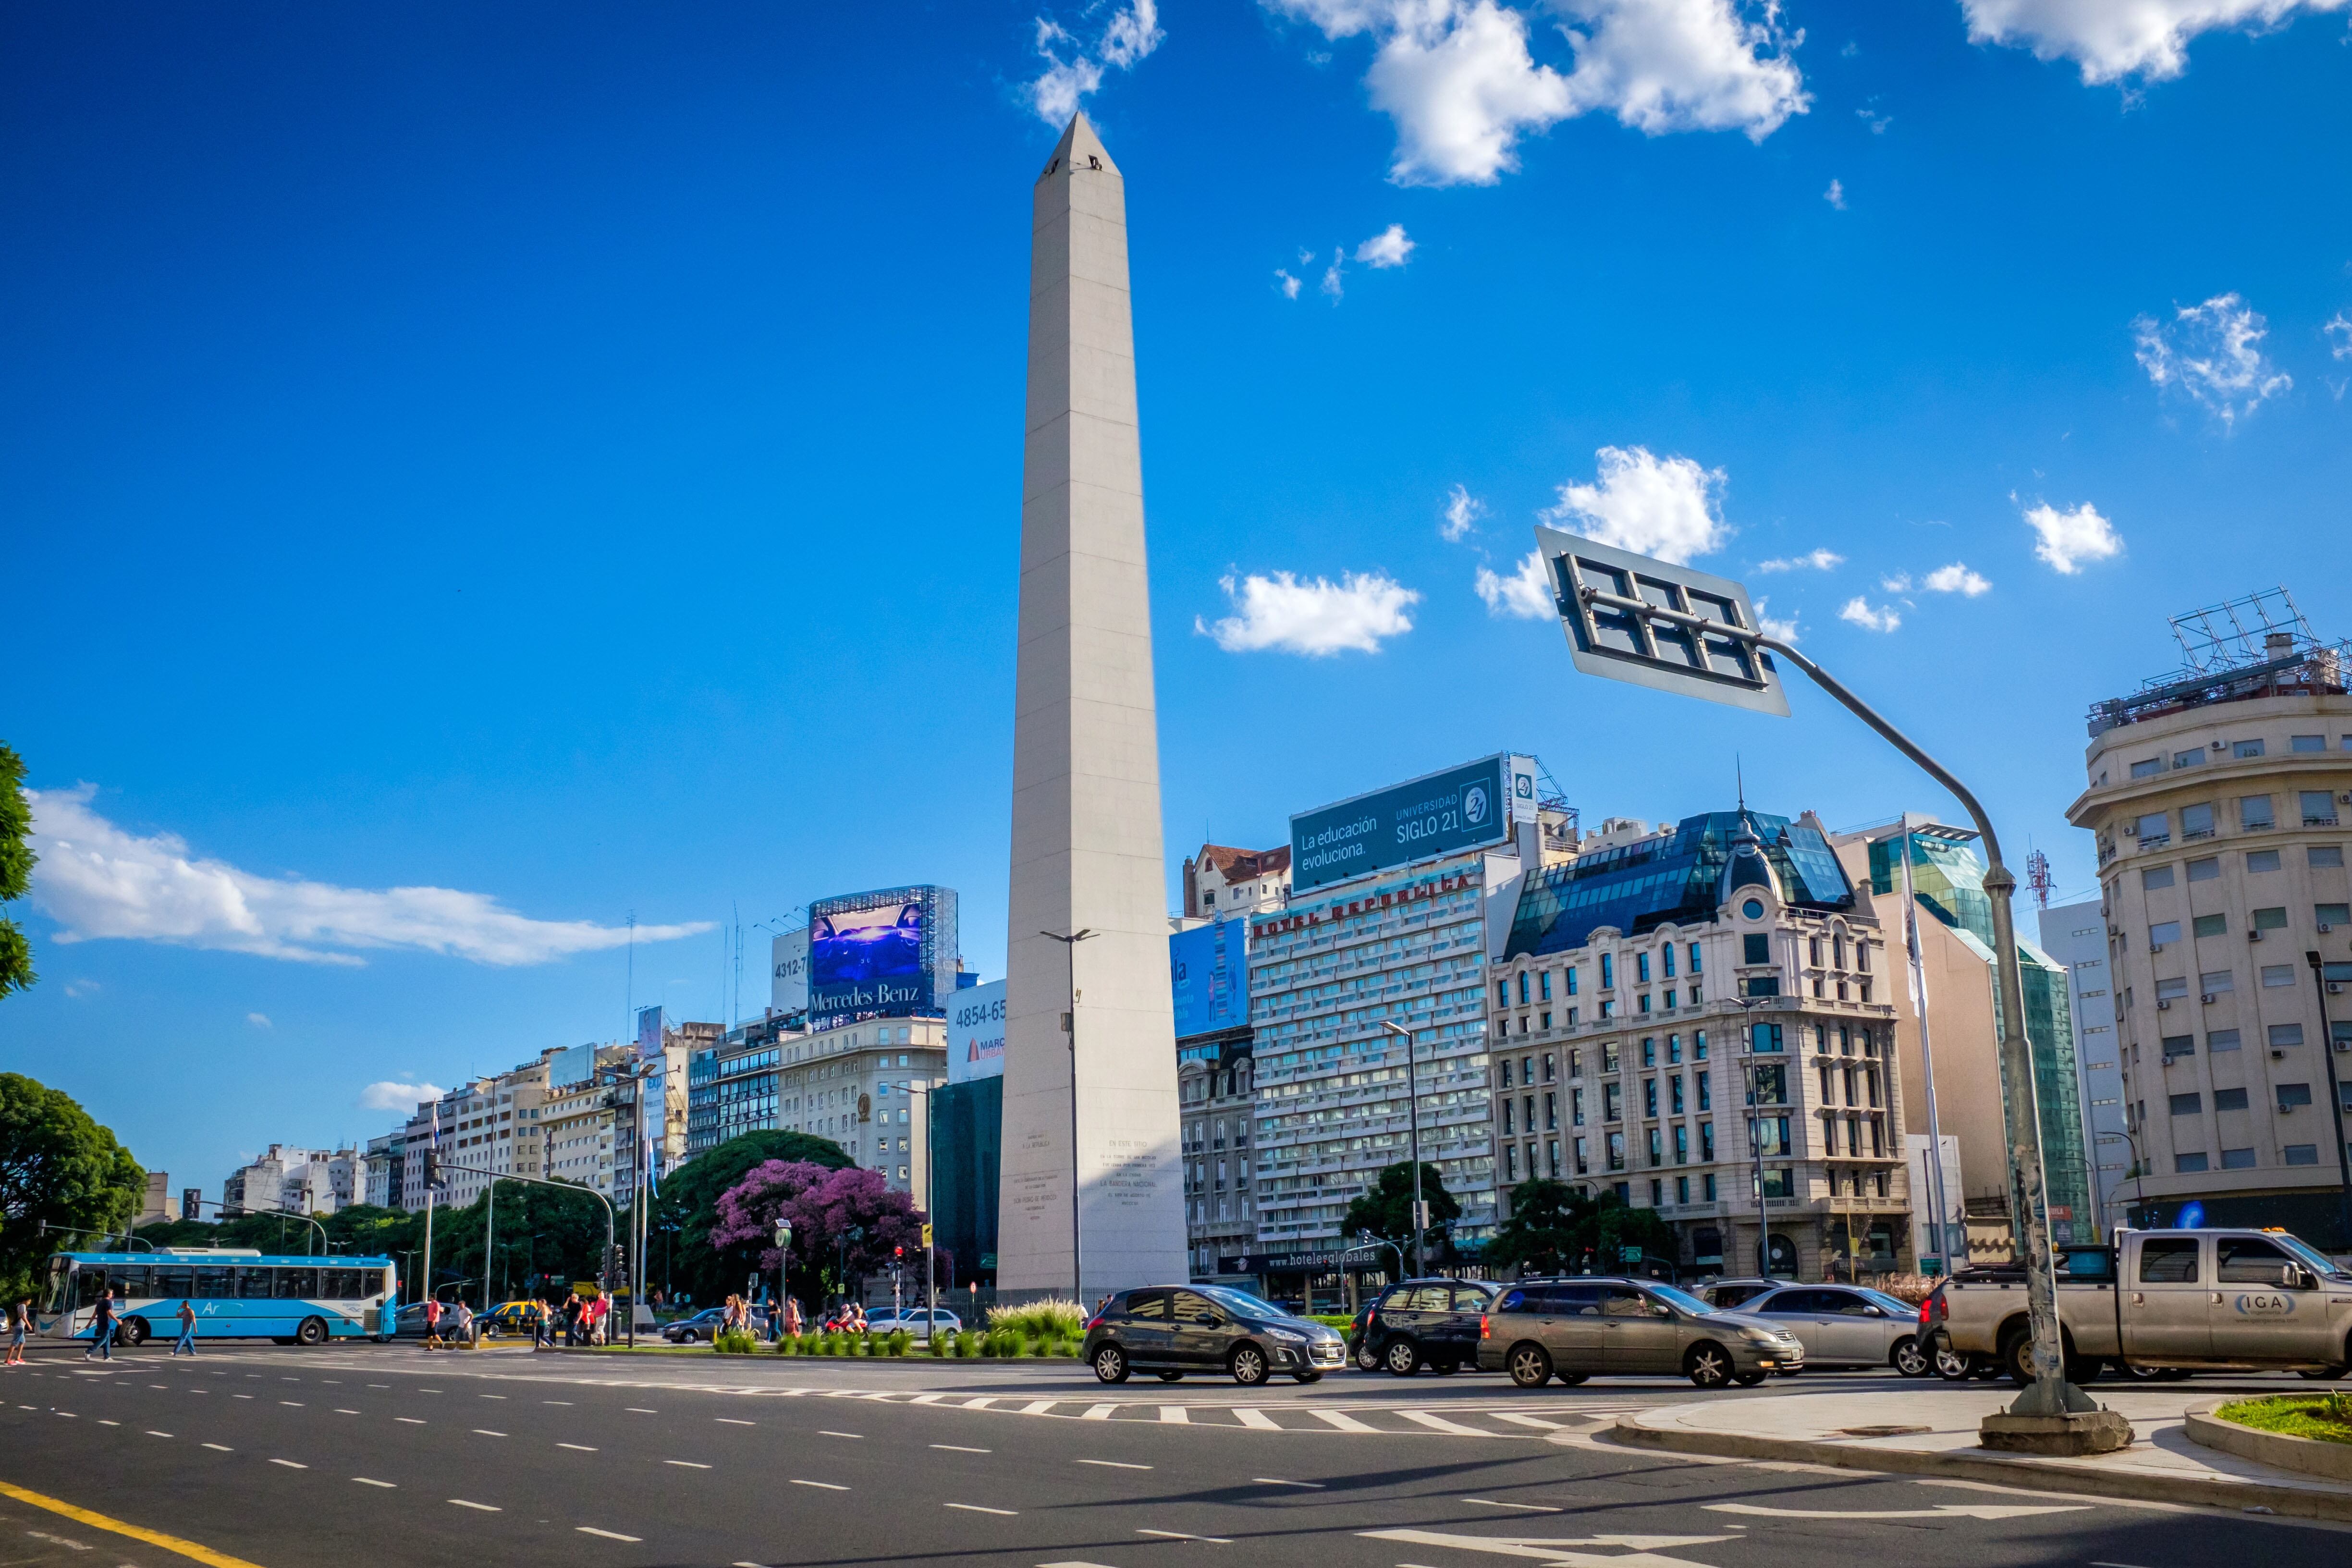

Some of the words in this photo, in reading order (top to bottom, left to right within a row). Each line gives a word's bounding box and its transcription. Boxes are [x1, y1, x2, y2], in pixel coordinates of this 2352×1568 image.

[1396, 794, 1458, 821] UNIVERSIDAD
[1467, 796, 1484, 820] 21
[1302, 835, 1315, 850] La
[1318, 816, 1377, 845] educación
[1397, 816, 1437, 844] SIGLO
[1442, 810, 1458, 832] 21
[1302, 843, 1366, 870] evoluciona.
[1253, 912, 1319, 937] HOTEL
[1332, 875, 1469, 920] REPUBLICA
[775, 956, 807, 979] 4312-7
[811, 984, 919, 1013] Mercedes-Benz
[956, 999, 1006, 1029] 4854-65
[980, 1037, 1005, 1051] MARC
[2246, 1296, 2282, 1308] IGA
